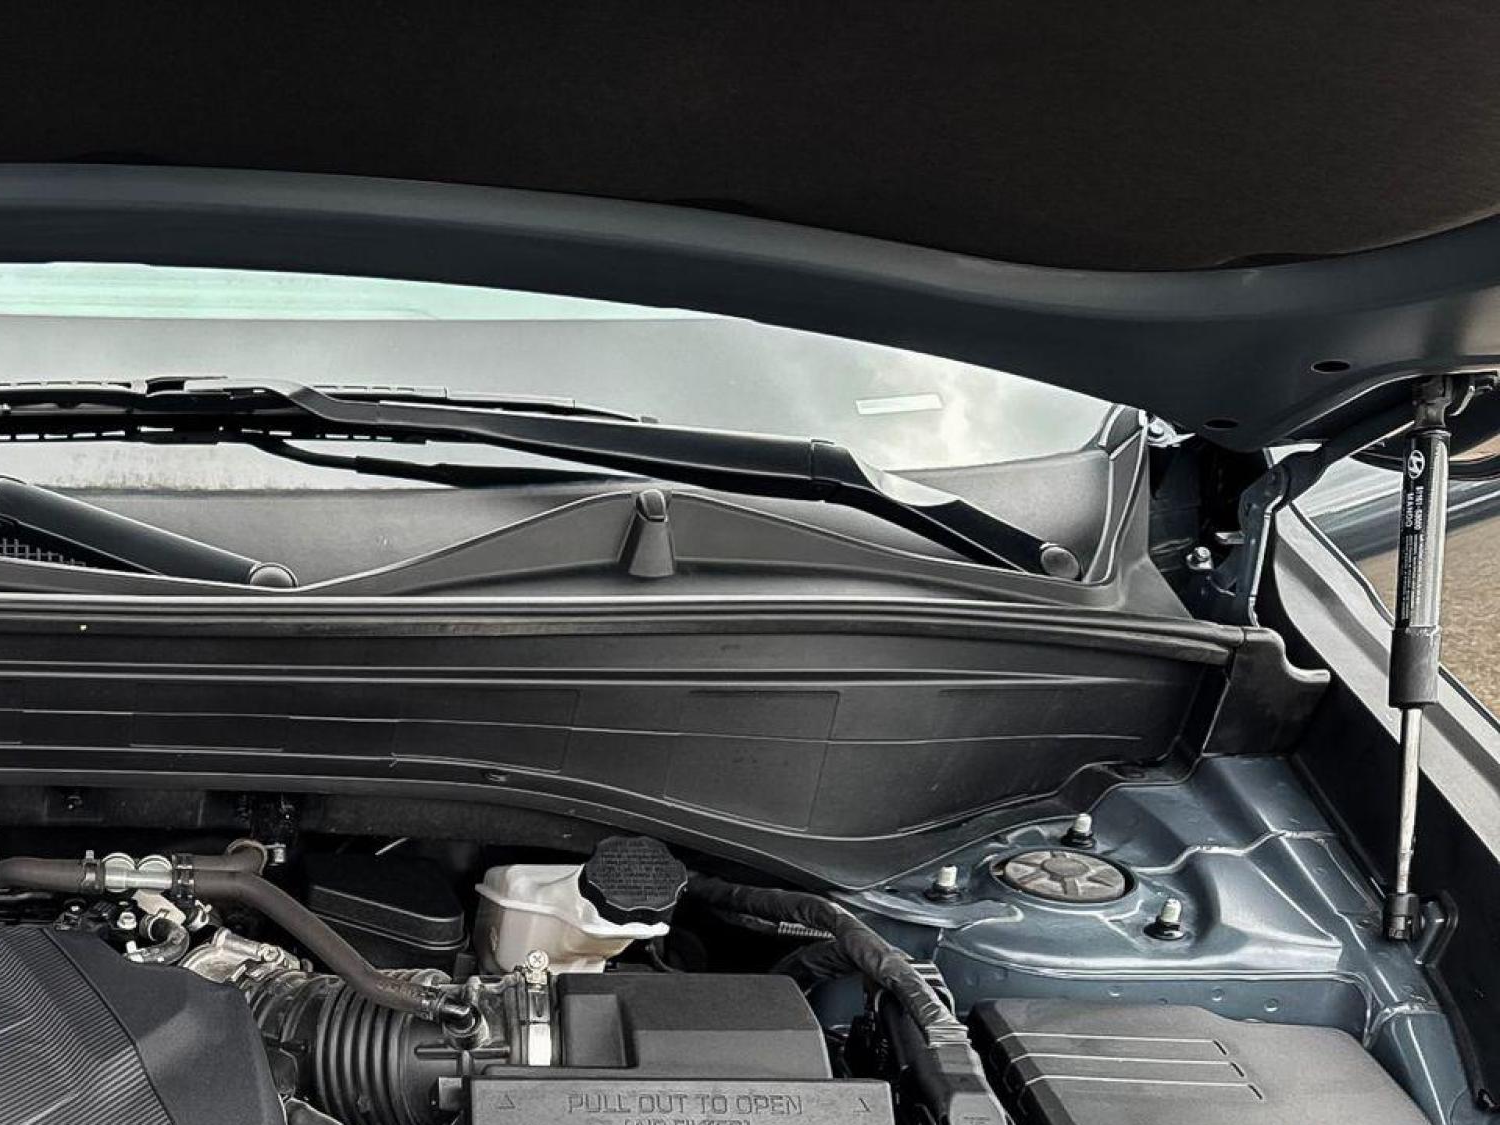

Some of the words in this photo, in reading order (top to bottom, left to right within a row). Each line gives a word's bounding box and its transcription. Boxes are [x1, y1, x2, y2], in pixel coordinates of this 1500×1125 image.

[1405, 493, 1415, 528] MANDO
[567, 1093, 631, 1114] PULL
[638, 1094, 688, 1115] OUT
[697, 1094, 729, 1115] TO
[736, 1095, 804, 1116] OPEN
